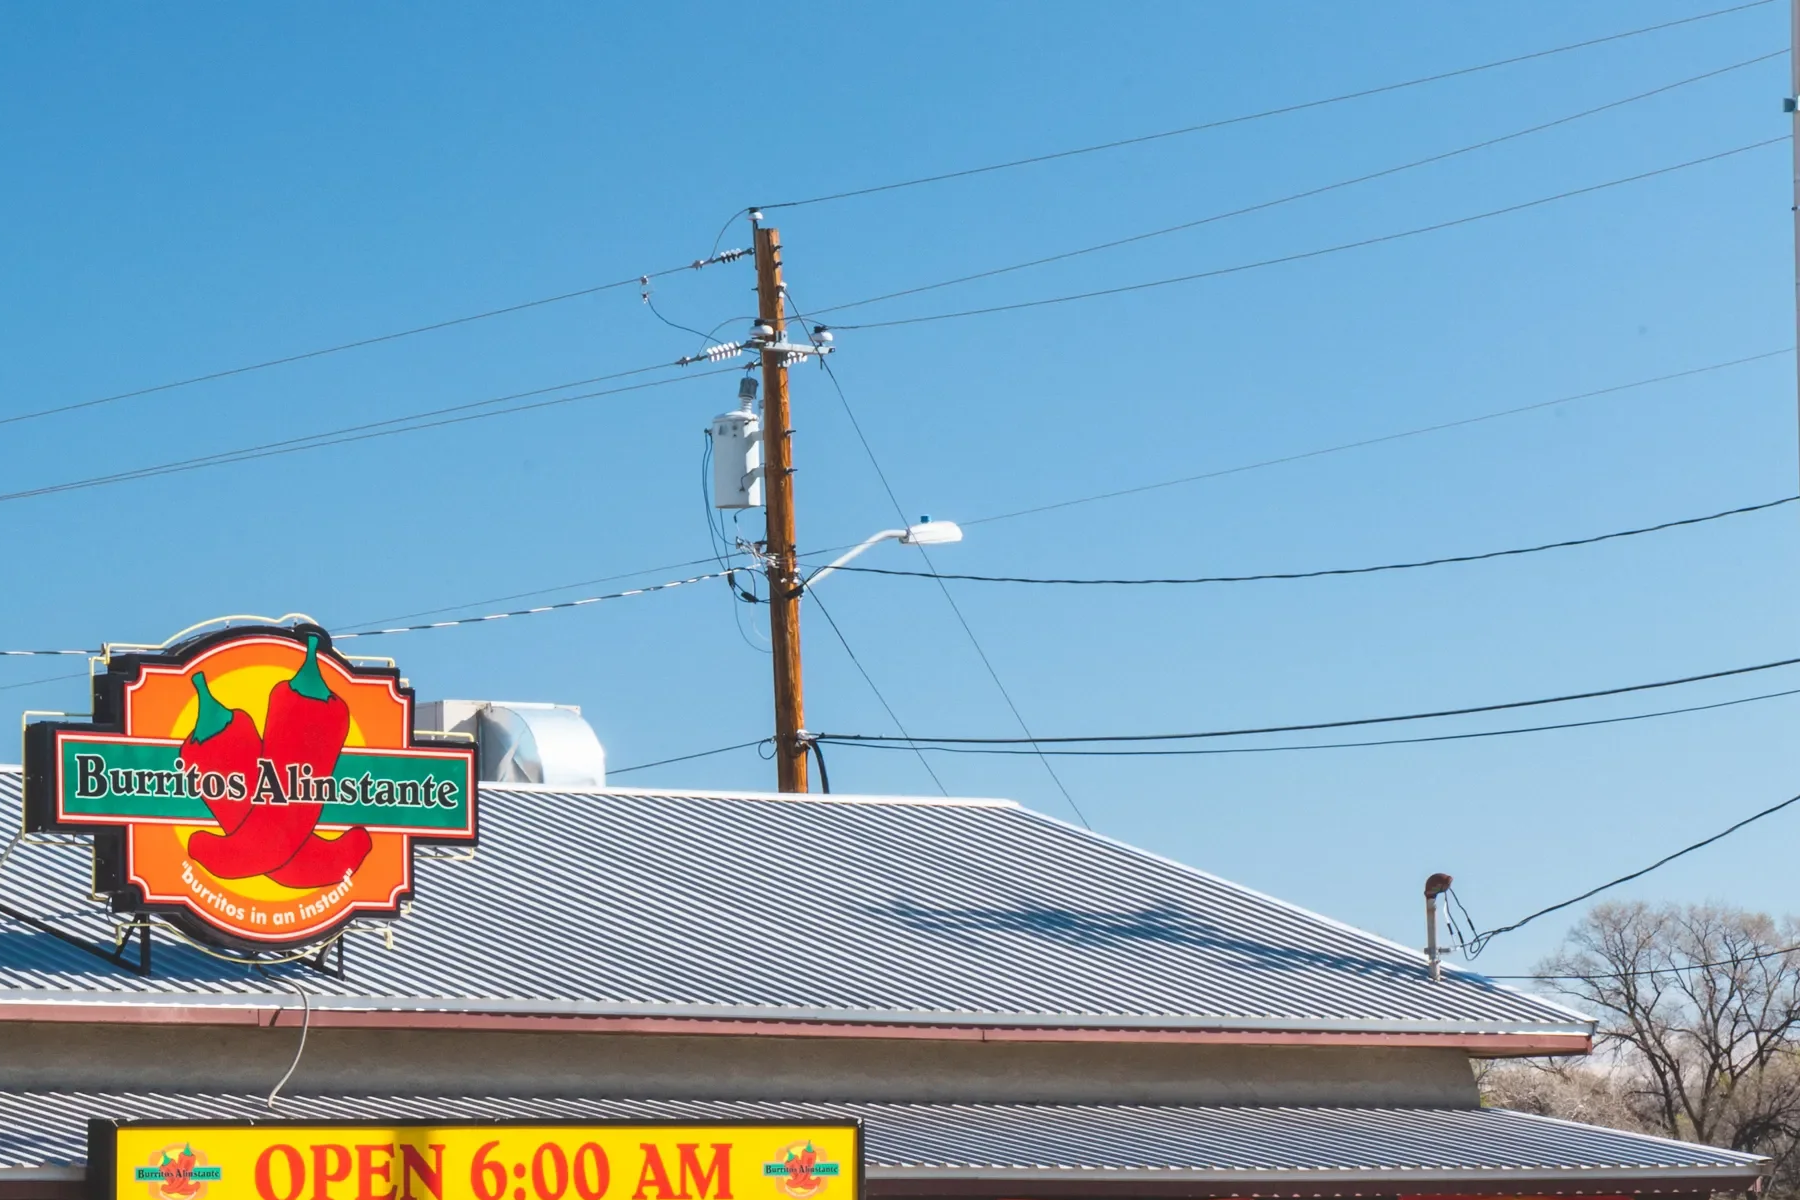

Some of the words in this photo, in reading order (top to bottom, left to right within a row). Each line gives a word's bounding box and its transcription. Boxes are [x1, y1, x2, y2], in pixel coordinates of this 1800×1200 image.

[75, 753, 247, 800] Burritos
[250, 758, 459, 810] Alinstante
[250, 907, 267, 925] in
[272, 910, 296, 926] an
[138, 1167, 174, 1179] Burritos
[765, 1164, 797, 1175] Burritos
